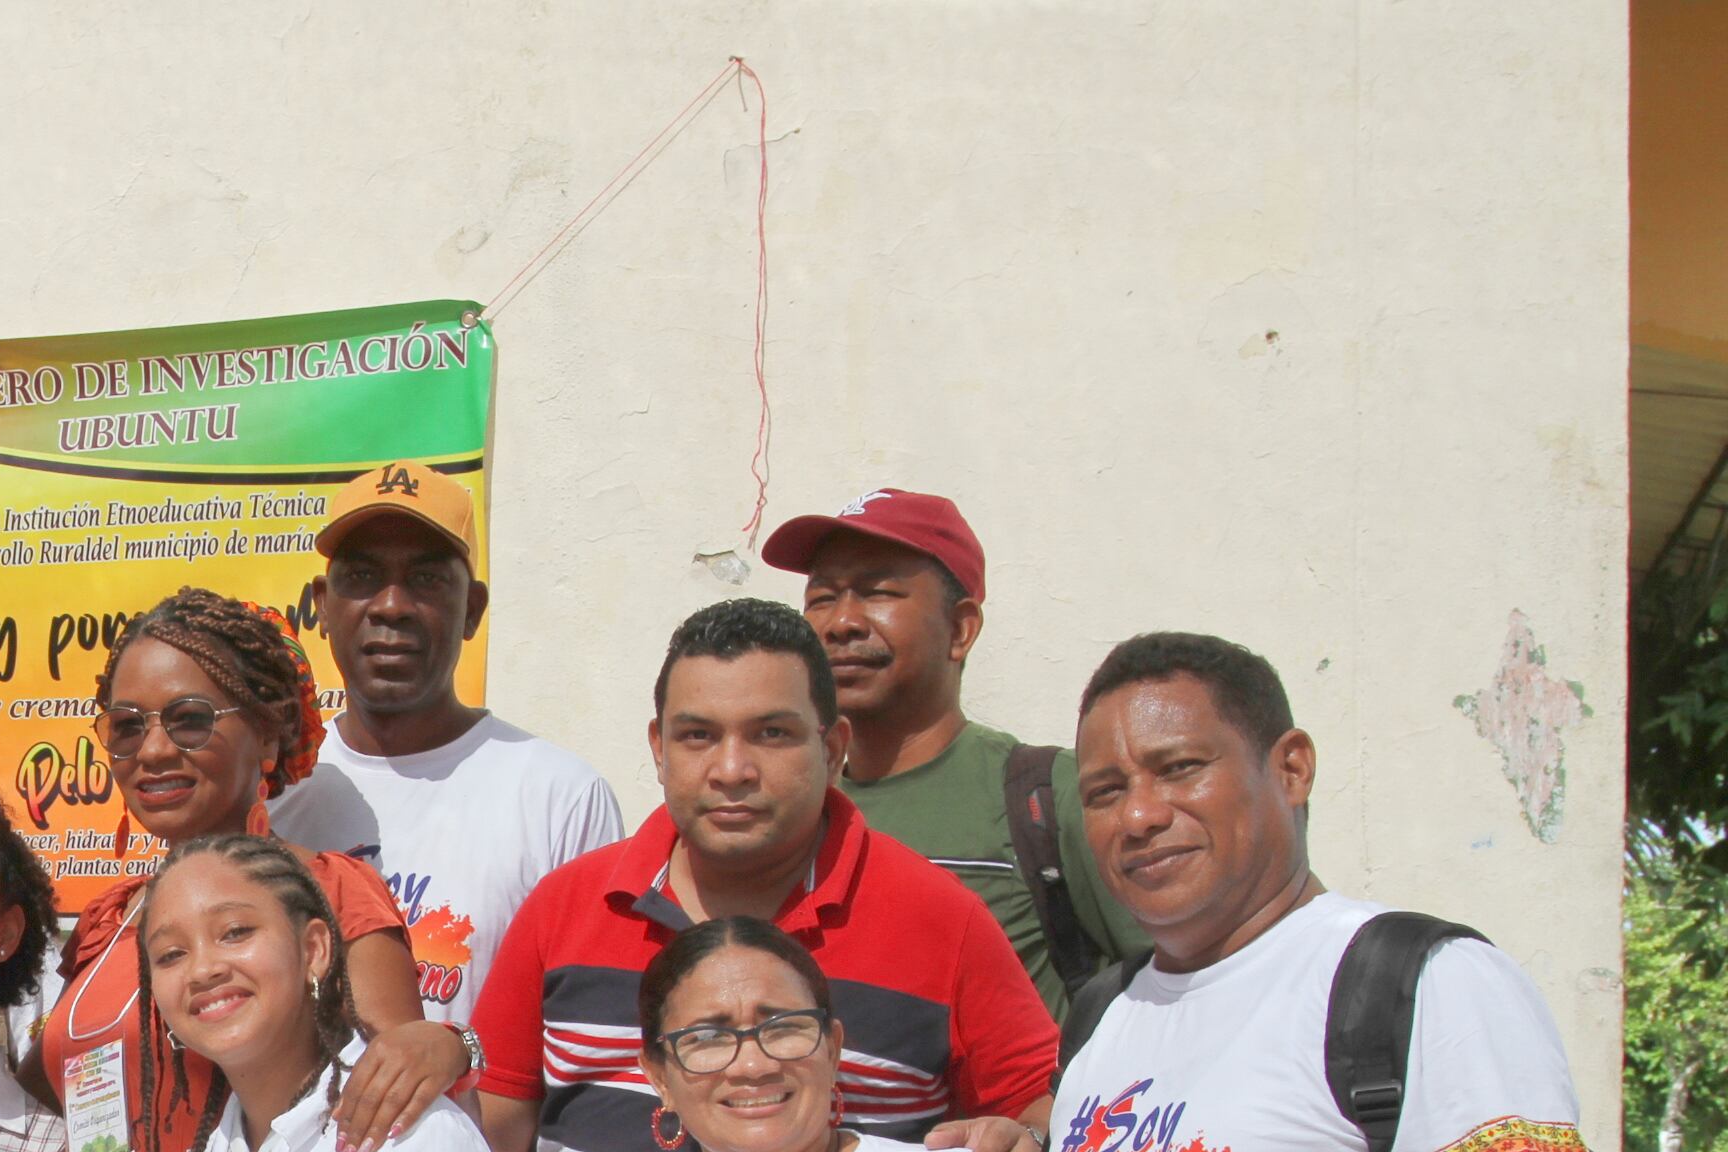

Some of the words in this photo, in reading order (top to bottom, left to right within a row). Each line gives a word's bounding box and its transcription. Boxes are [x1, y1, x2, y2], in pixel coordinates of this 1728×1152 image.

[73, 357, 129, 402] DE
[138, 323, 470, 396] INVESTIGACIÓN
[58, 404, 241, 453] UBUNTU
[376, 463, 419, 497] LA
[3, 502, 101, 532] Institución
[106, 494, 243, 526] Etnoeducativa
[249, 491, 326, 519] Técnica
[39, 535, 119, 565] Ruraldel
[124, 532, 220, 564] municipio
[225, 529, 249, 555] de
[15, 736, 114, 829] Pelo
[65, 829, 138, 851] hidratr
[55, 856, 120, 880] plantas
